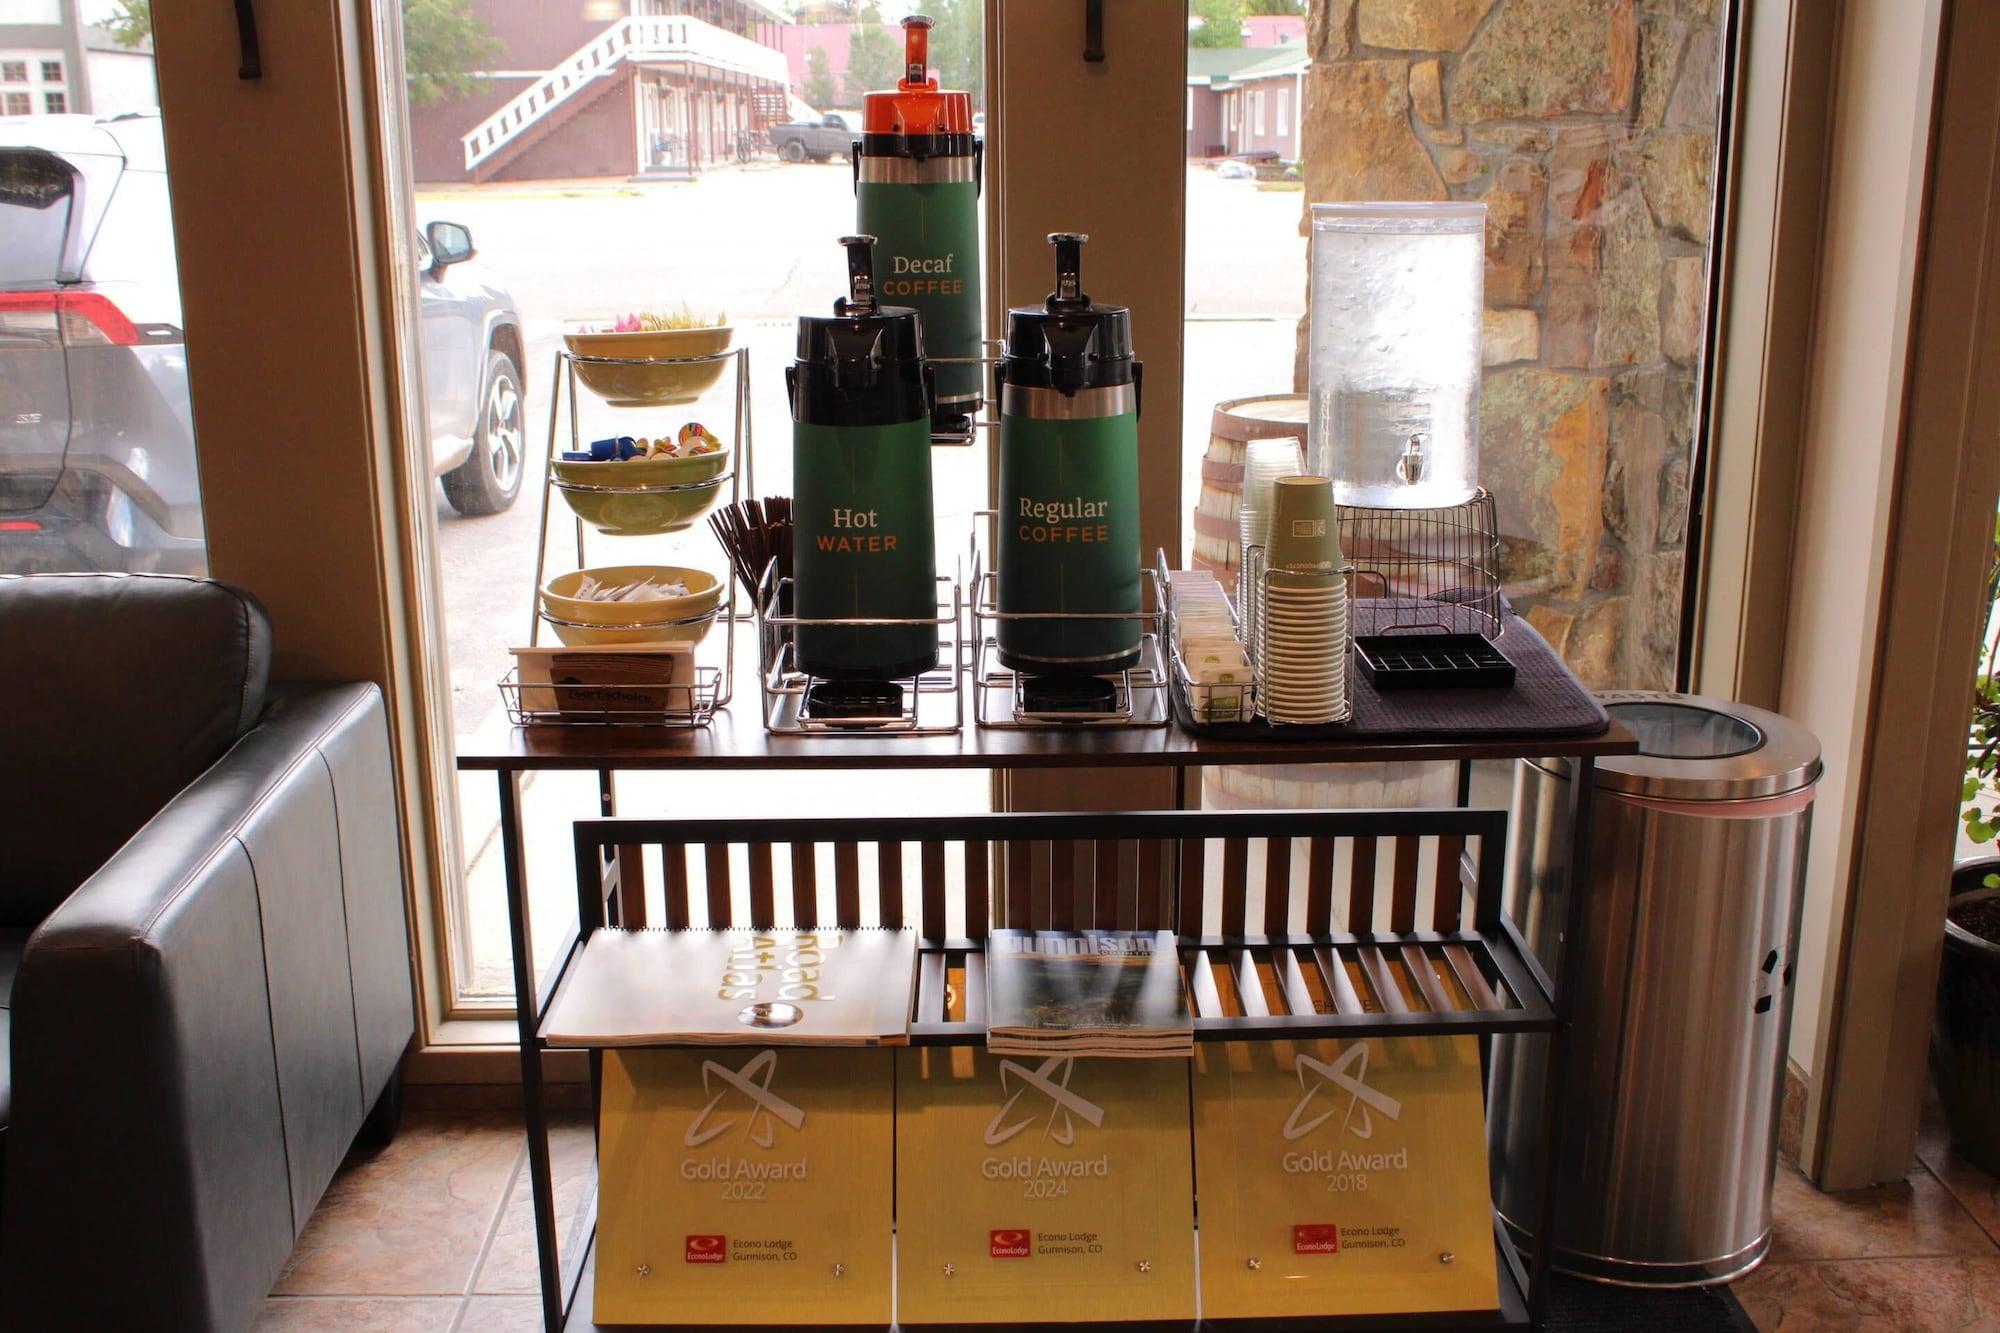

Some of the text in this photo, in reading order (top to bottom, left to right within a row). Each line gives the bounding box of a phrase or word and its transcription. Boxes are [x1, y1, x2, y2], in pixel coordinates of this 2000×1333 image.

[893, 253, 954, 274] Decaf
[883, 280, 962, 296] COFFEE
[833, 508, 878, 528] Hot
[1019, 496, 1108, 524] Regular
[1019, 525, 1109, 543] COFFEE
[816, 535, 897, 552] WATER
[681, 1156, 807, 1179] Gold Award
[982, 1154, 1108, 1178] Gold Award
[1283, 1147, 1408, 1173] Gold Award
[721, 1182, 766, 1200] 2022
[1023, 1180, 1069, 1198] 2024
[1327, 1174, 1368, 1192] 2018
[1038, 1231, 1097, 1243] Econo Lodge
[1341, 1226, 1400, 1237] Econo Lodge
[733, 1239, 793, 1251] Econo Lodge
[992, 1246, 1029, 1255] EconoLodge
[1038, 1244, 1102, 1255] Gunnison, CO
[1297, 1242, 1336, 1252] EconoLodge
[1342, 1238, 1405, 1250] Gunnison, CO
[687, 1252, 724, 1261] EconoLodge
[733, 1252, 797, 1262] Gunnison, CO
